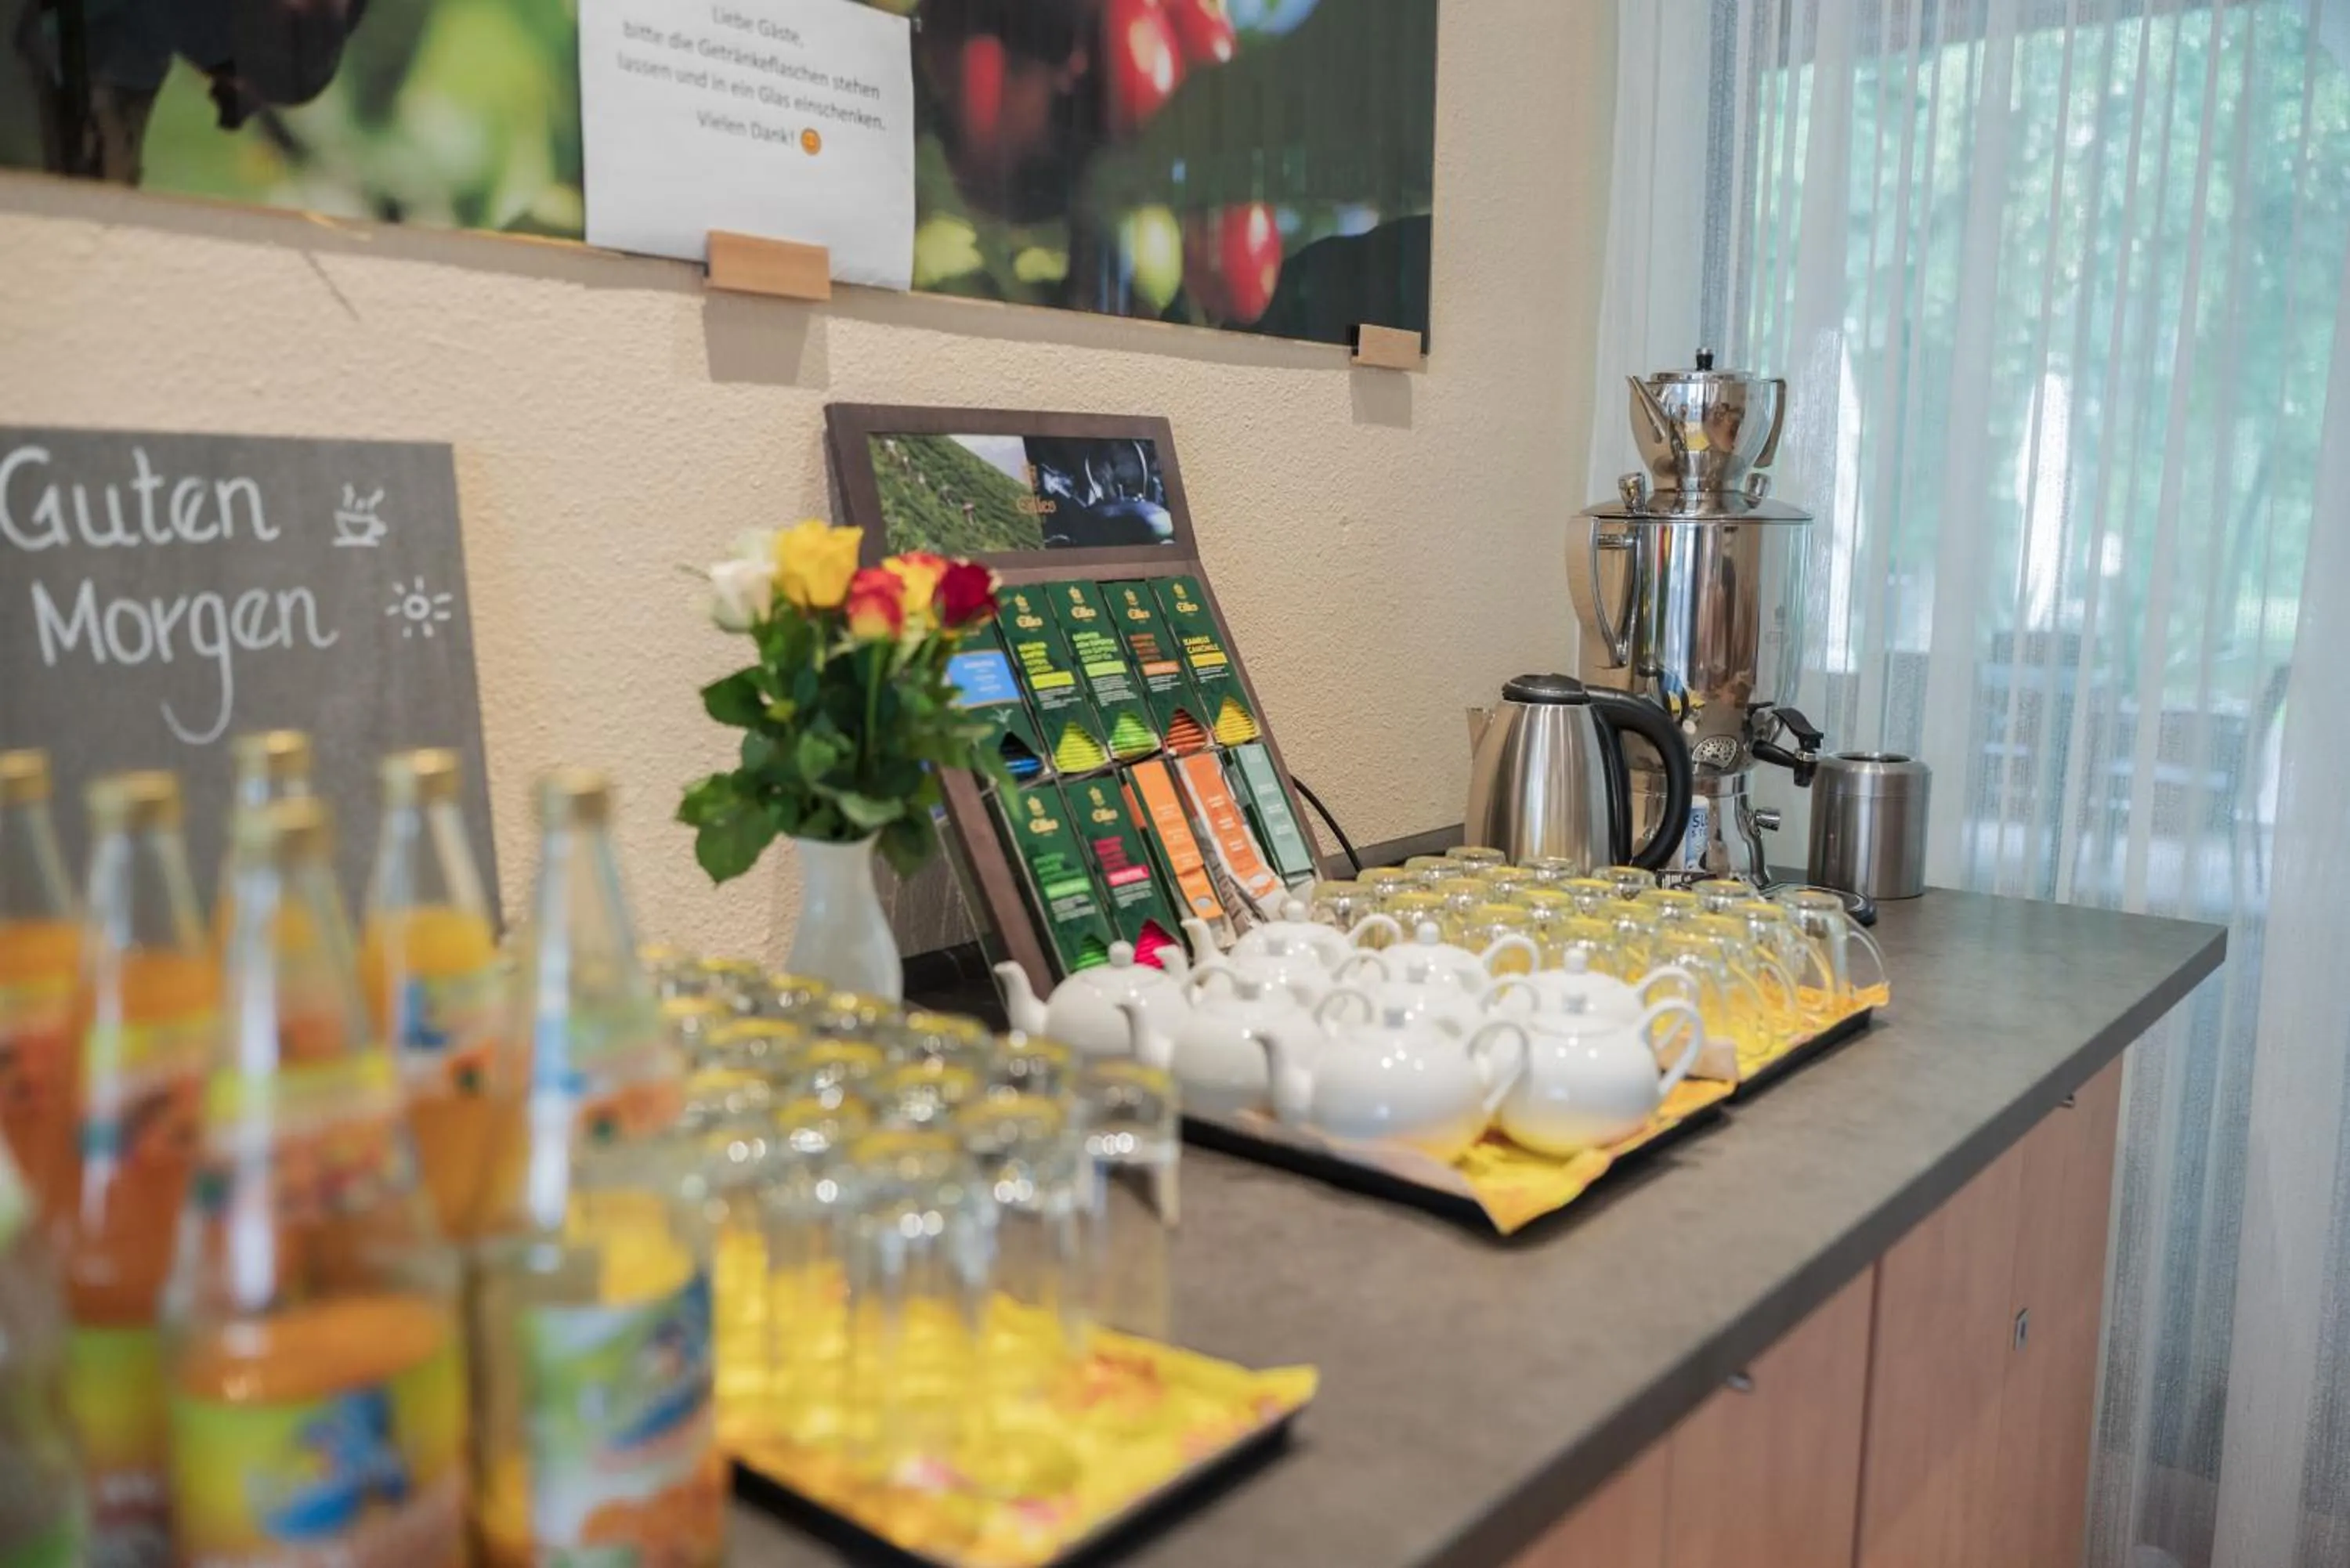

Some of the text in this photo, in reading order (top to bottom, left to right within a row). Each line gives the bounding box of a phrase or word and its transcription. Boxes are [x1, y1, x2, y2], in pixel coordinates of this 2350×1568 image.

[622, 20, 880, 100] bitte die Getränkeflaschen stehen
[711, 5, 804, 49] Liebe Gäste,
[616, 50, 886, 132] lassen und in ein Glas einschenken.
[696, 110, 794, 147] Vielen Dank!
[0, 444, 280, 551] Guten
[31, 577, 339, 745] Morgen
